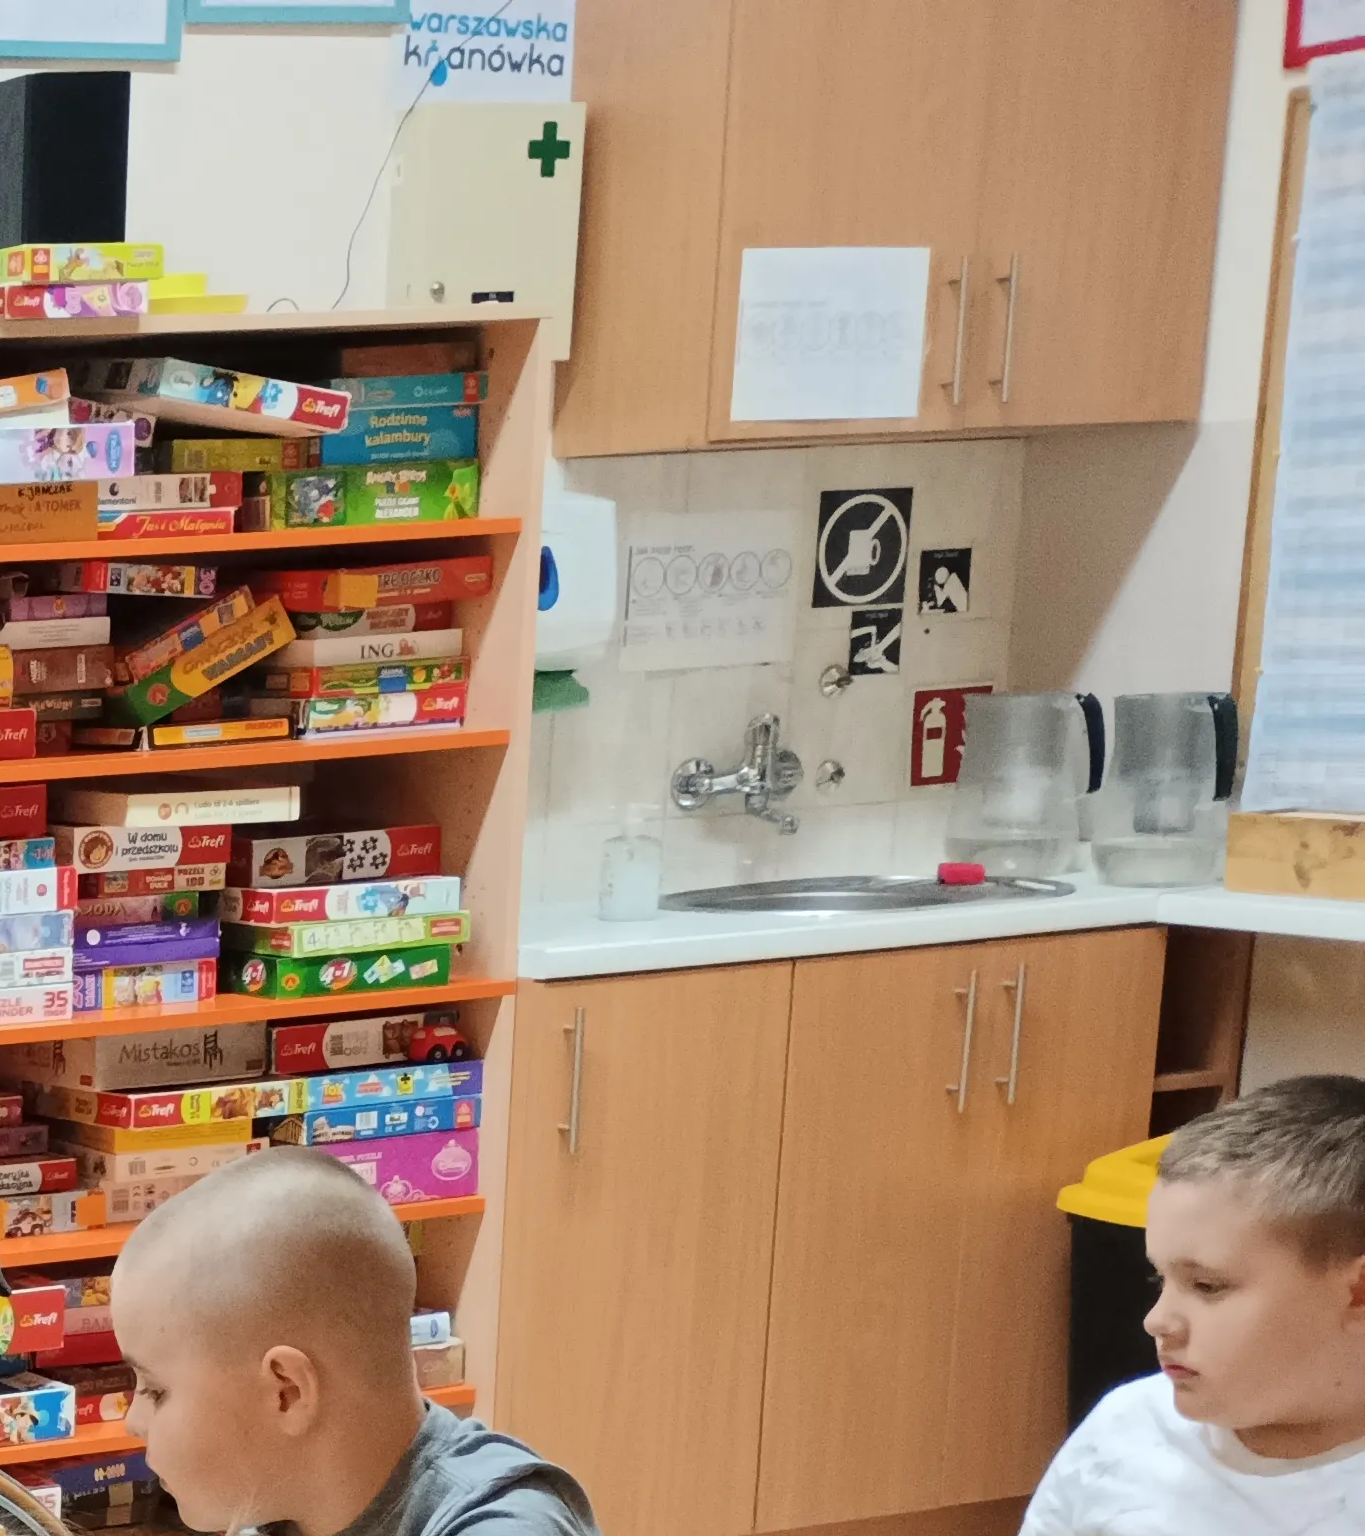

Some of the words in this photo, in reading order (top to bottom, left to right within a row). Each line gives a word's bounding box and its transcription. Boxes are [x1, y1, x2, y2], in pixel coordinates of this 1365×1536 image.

[409, 13, 568, 42] warszawska
[403, 35, 565, 77] kranówka
[315, 401, 342, 418] Trefl
[365, 429, 432, 447] kalambury
[360, 643, 395, 660] ING
[2, 727, 29, 742] Trefl
[12, 803, 40, 819] Trefl
[127, 832, 139, 845] W
[140, 831, 168, 843] domu
[201, 834, 226, 849] Trefl
[120, 843, 179, 857] przedszkolu
[408, 842, 434, 856] Trefl
[292, 897, 320, 913] Trefl
[43, 990, 69, 1009] 35
[118, 1038, 201, 1065] Mistakos
[293, 1042, 317, 1055] Trefl
[150, 1102, 176, 1116] Trefl
[32, 1312, 58, 1326] Trefl
